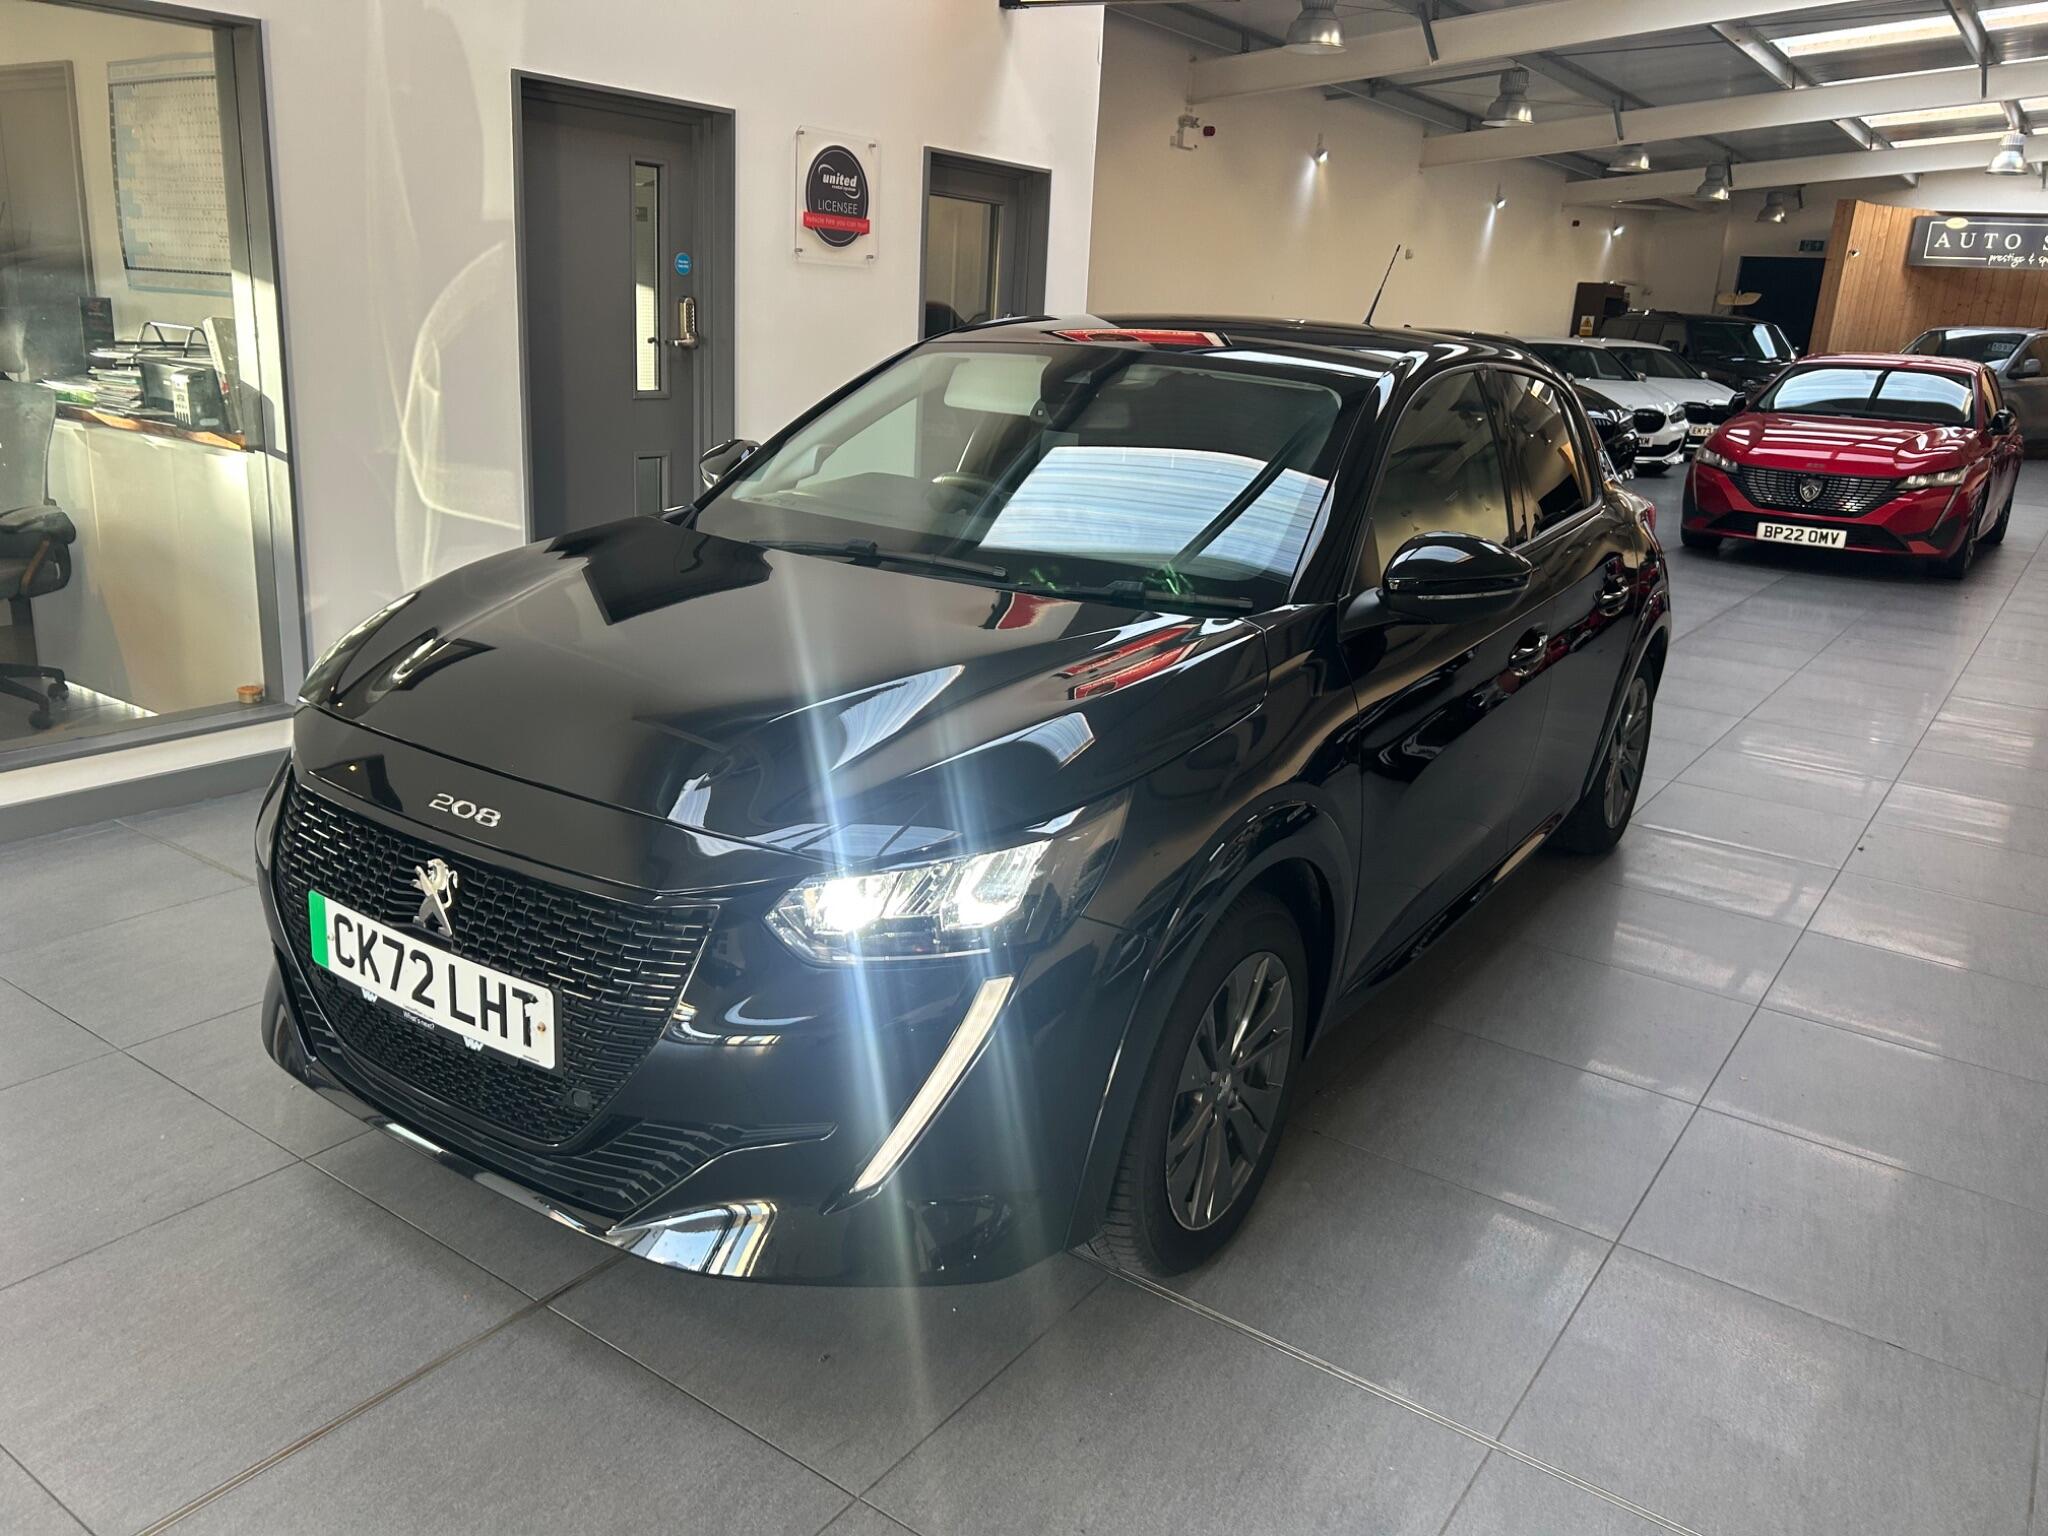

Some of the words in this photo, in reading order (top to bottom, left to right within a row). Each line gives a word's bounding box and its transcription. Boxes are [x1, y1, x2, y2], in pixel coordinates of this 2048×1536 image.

[823, 172, 858, 187] united
[818, 199, 858, 214] LICENSEE
[1933, 231, 2022, 250] AUTO
[1987, 252, 2026, 268] prestige
[1763, 525, 1804, 542] BP22
[1808, 530, 1840, 545] OMV
[429, 793, 502, 828] 208
[334, 913, 436, 1010] CK72
[448, 963, 539, 1048] LHT
